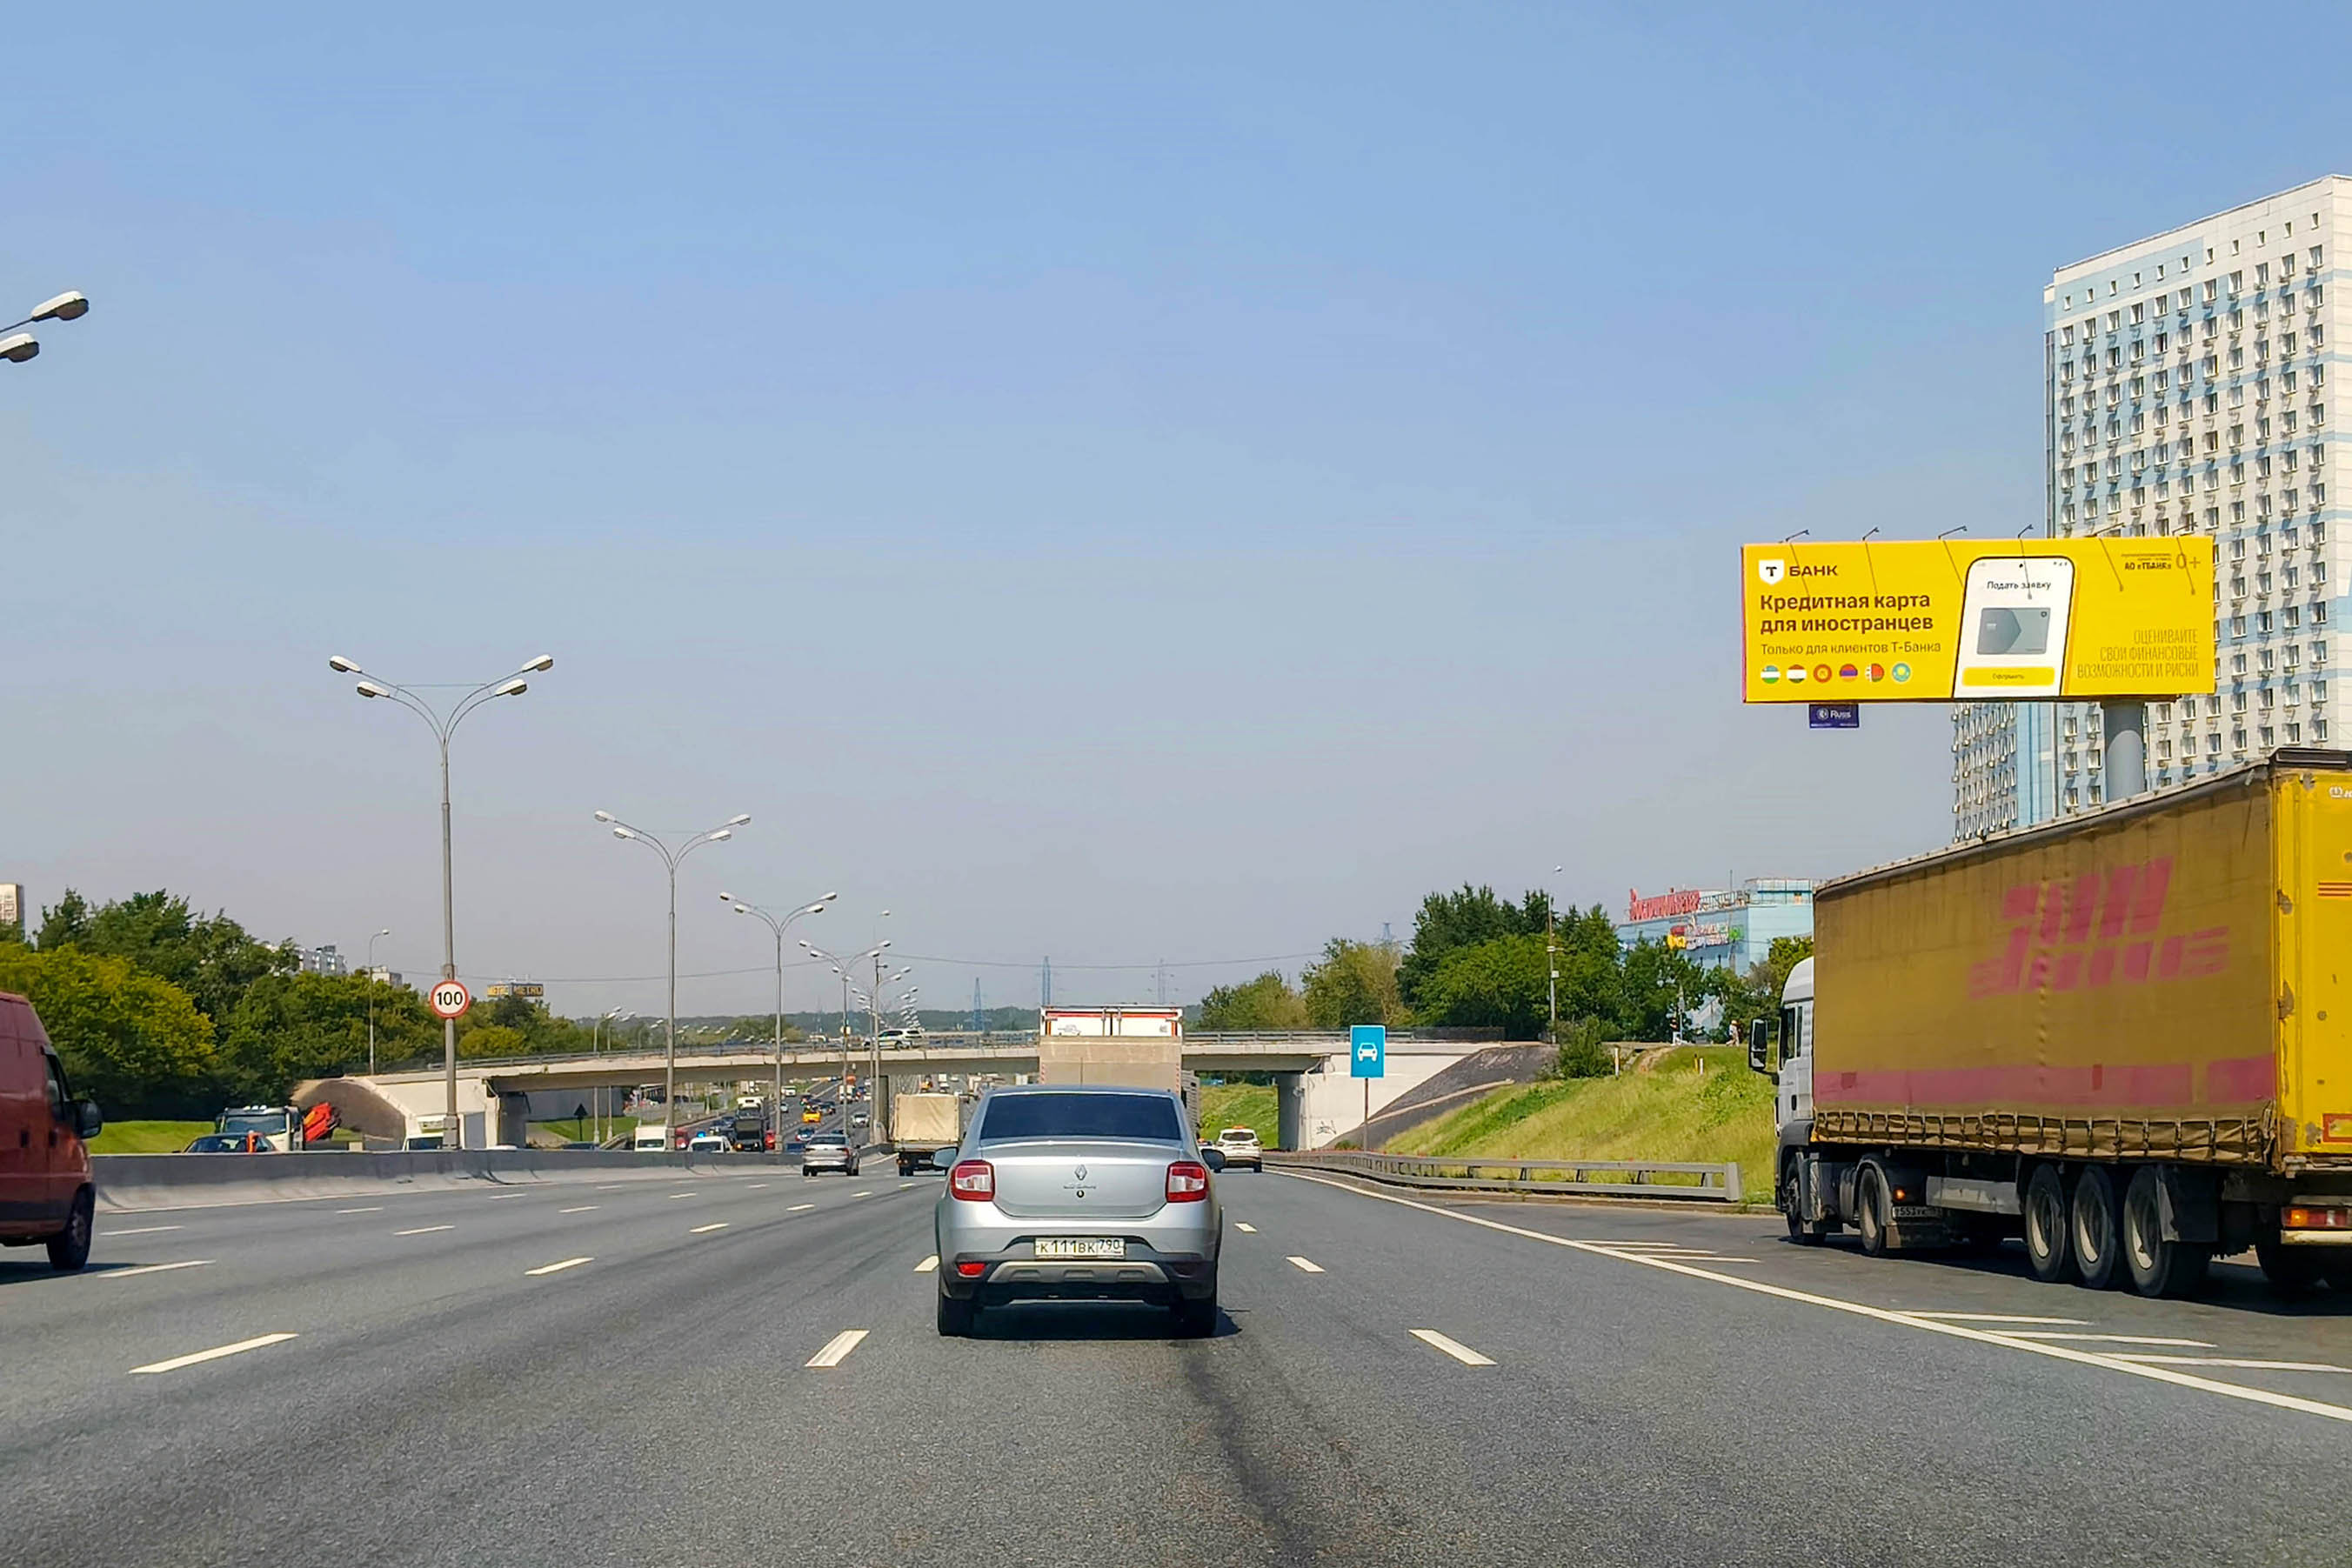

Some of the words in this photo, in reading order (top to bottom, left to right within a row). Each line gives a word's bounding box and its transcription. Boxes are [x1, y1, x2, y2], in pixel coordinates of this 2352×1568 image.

[2176, 553, 2202, 570] 0+
[1789, 565, 1838, 577] БАНК
[1987, 581, 2019, 591] Подать
[2021, 581, 2052, 591] заявку
[1760, 594, 1870, 614] Кредитная
[1874, 594, 1931, 612] карта
[1760, 618, 1797, 635] для
[1801, 617, 1934, 635] иностранцев
[2134, 627, 2199, 645] ОЦЕНИВАЙТЕ
[1761, 644, 1803, 655] Только
[1806, 644, 1827, 656] для
[1831, 643, 1888, 654] клиентов
[1891, 641, 1941, 653] Т-Банка
[2100, 646, 2128, 662] СВОИ
[2129, 645, 2199, 661] ФИНАНСОВЫЕ
[2076, 663, 2154, 679] ВОЗМОЖНОСТИ
[2156, 663, 2163, 677] И
[2166, 663, 2199, 678] РИСКИ
[437, 991, 463, 1006] 100
